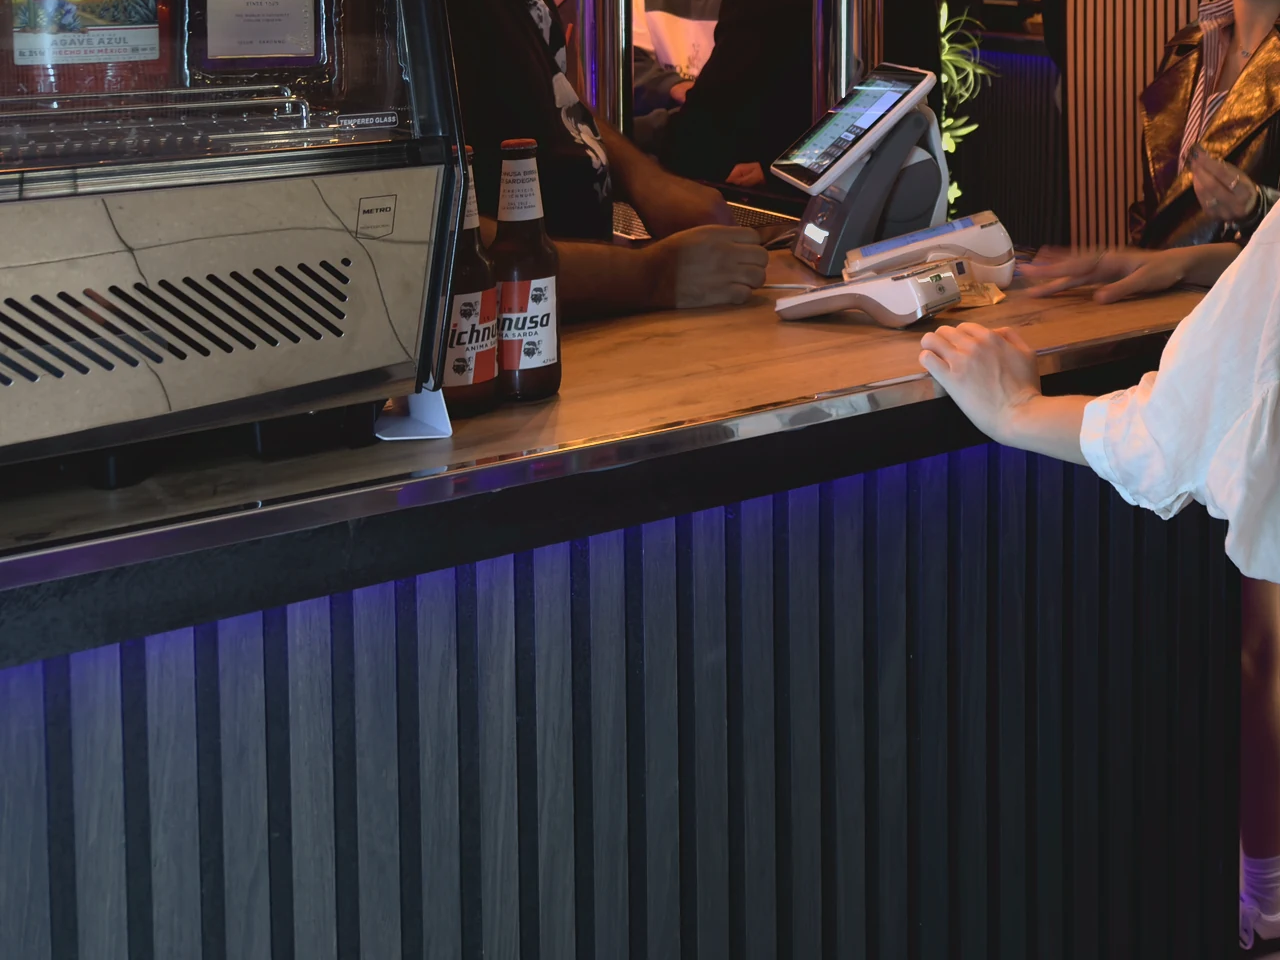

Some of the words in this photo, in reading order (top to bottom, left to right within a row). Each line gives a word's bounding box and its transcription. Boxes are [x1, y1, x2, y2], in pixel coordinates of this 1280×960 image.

[97, 36, 129, 46] AZUL
[339, 117, 374, 126] TEMPERED
[375, 116, 397, 124] GLASS
[362, 206, 392, 215] METRO
[499, 312, 550, 332] nusa
[448, 323, 497, 349] ichnu
[465, 343, 488, 352] ANIMA
